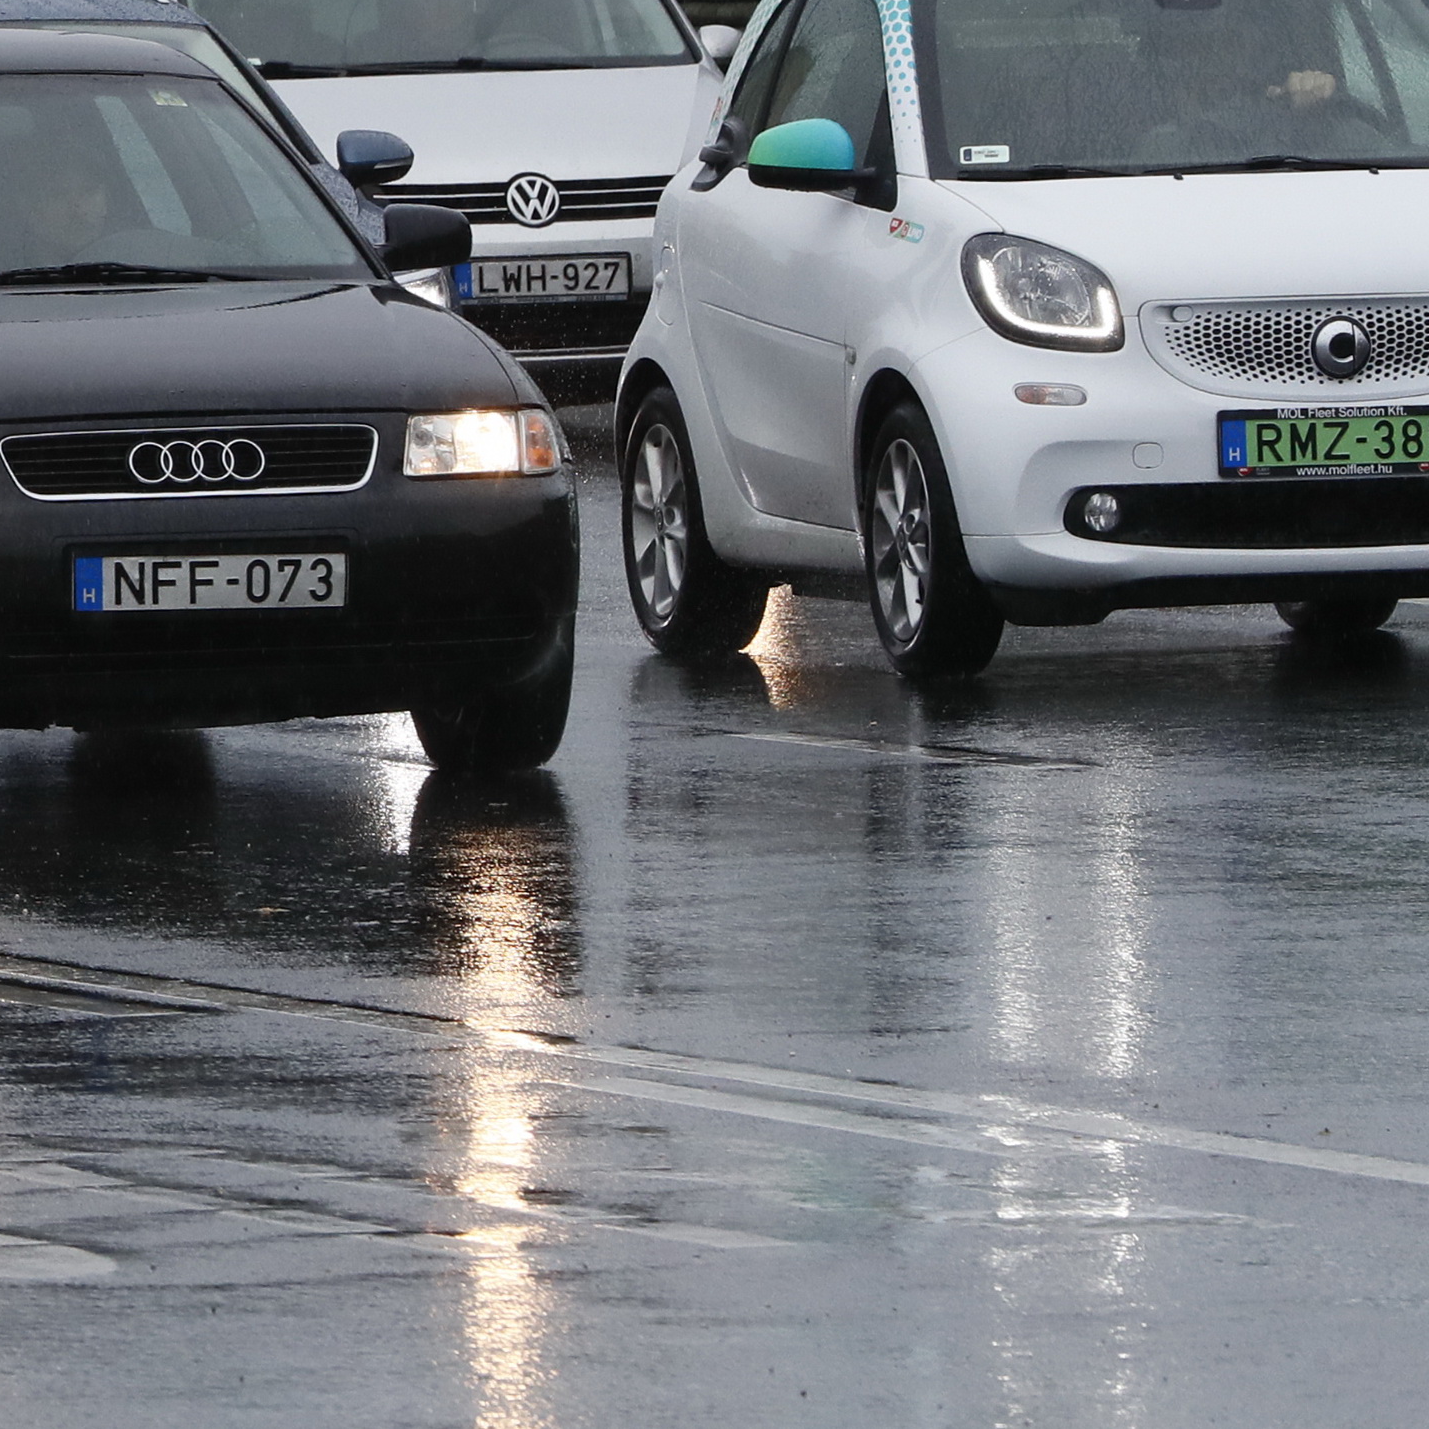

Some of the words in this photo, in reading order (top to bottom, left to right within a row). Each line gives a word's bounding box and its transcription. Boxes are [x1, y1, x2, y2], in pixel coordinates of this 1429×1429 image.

[508, 175, 559, 225] VW
[459, 282, 468, 294] H
[478, 261, 621, 294] LWH-927
[1277, 408, 1305, 419] MOL
[1308, 407, 1336, 418] Fleet
[1338, 406, 1385, 418] Solution
[1387, 405, 1408, 417] Kft.
[1228, 447, 1241, 462] H
[1256, 419, 1425, 463] RMZ-38
[1296, 463, 1393, 476] www.molfleet.hu
[82, 588, 96, 604] H
[114, 557, 334, 606] NFF-073
